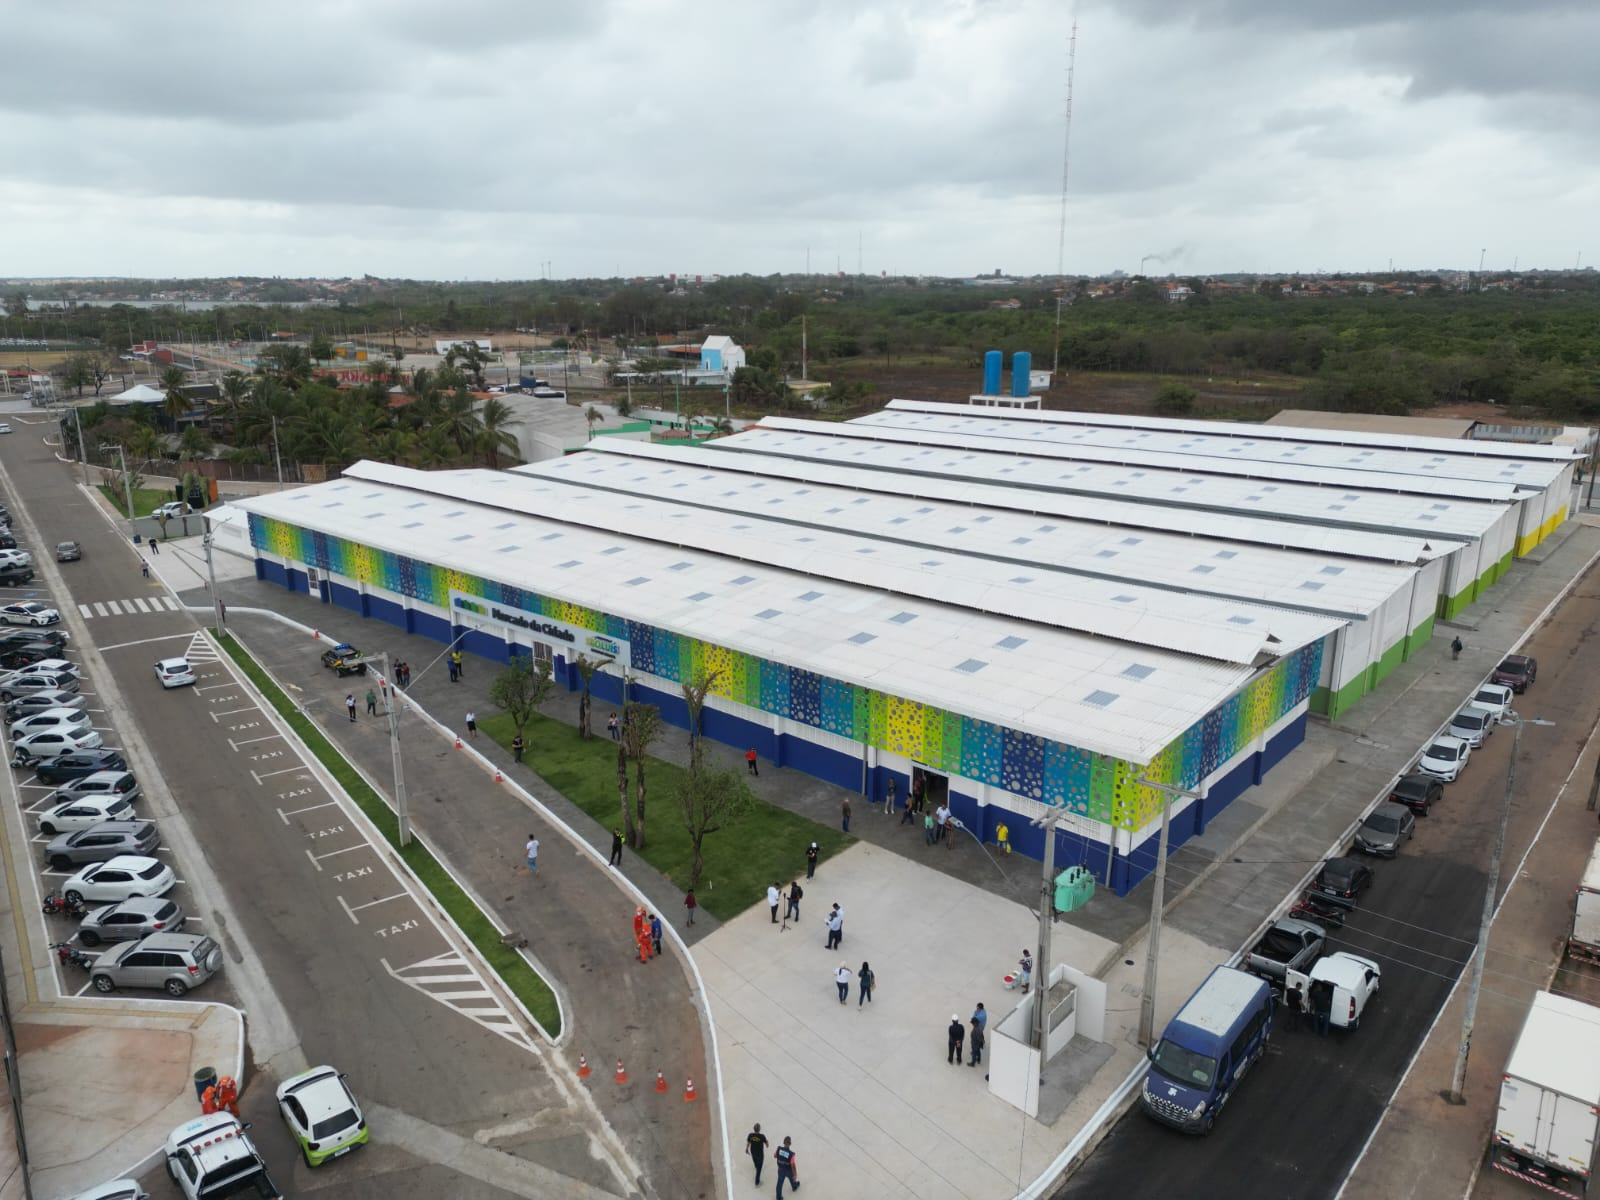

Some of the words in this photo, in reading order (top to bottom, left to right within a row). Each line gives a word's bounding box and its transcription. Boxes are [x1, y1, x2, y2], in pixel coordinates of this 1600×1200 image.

[209, 695, 238, 703] TAXI
[230, 721, 260, 731] TAXI
[250, 751, 283, 760] TAXI
[278, 787, 312, 799] TAXI
[305, 825, 344, 839] TAXI
[332, 866, 373, 882] TAXI
[375, 919, 419, 937] TAXI
